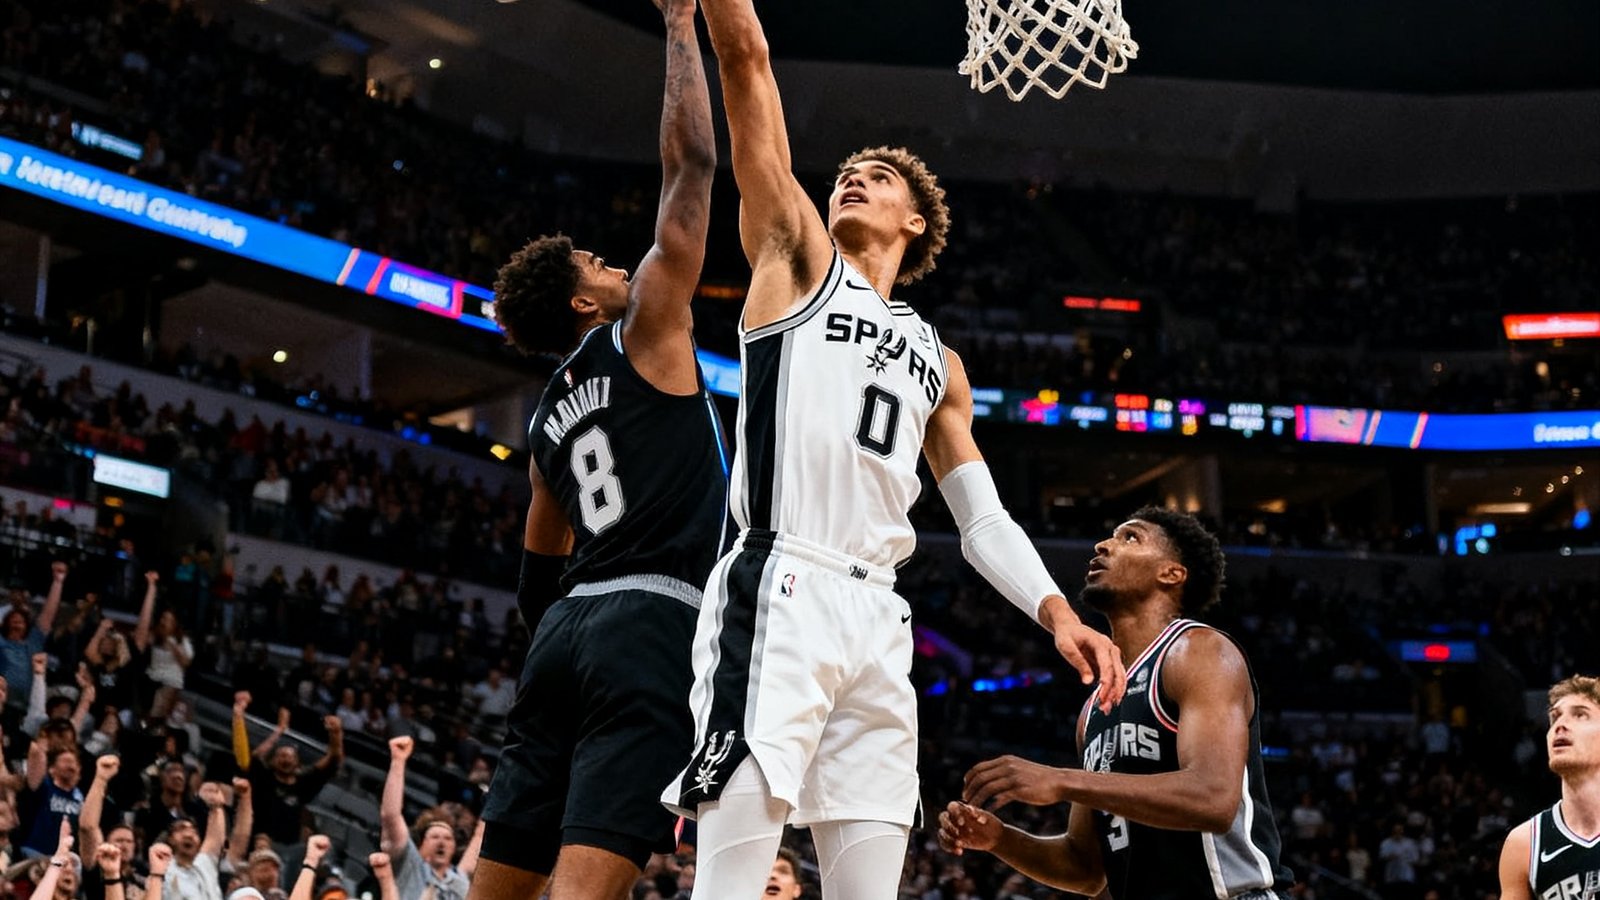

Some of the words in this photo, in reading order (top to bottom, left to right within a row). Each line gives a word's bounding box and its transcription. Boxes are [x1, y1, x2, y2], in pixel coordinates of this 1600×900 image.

[825, 313, 942, 408] SPURS
[854, 382, 903, 460] 0
[570, 424, 625, 536] 8
